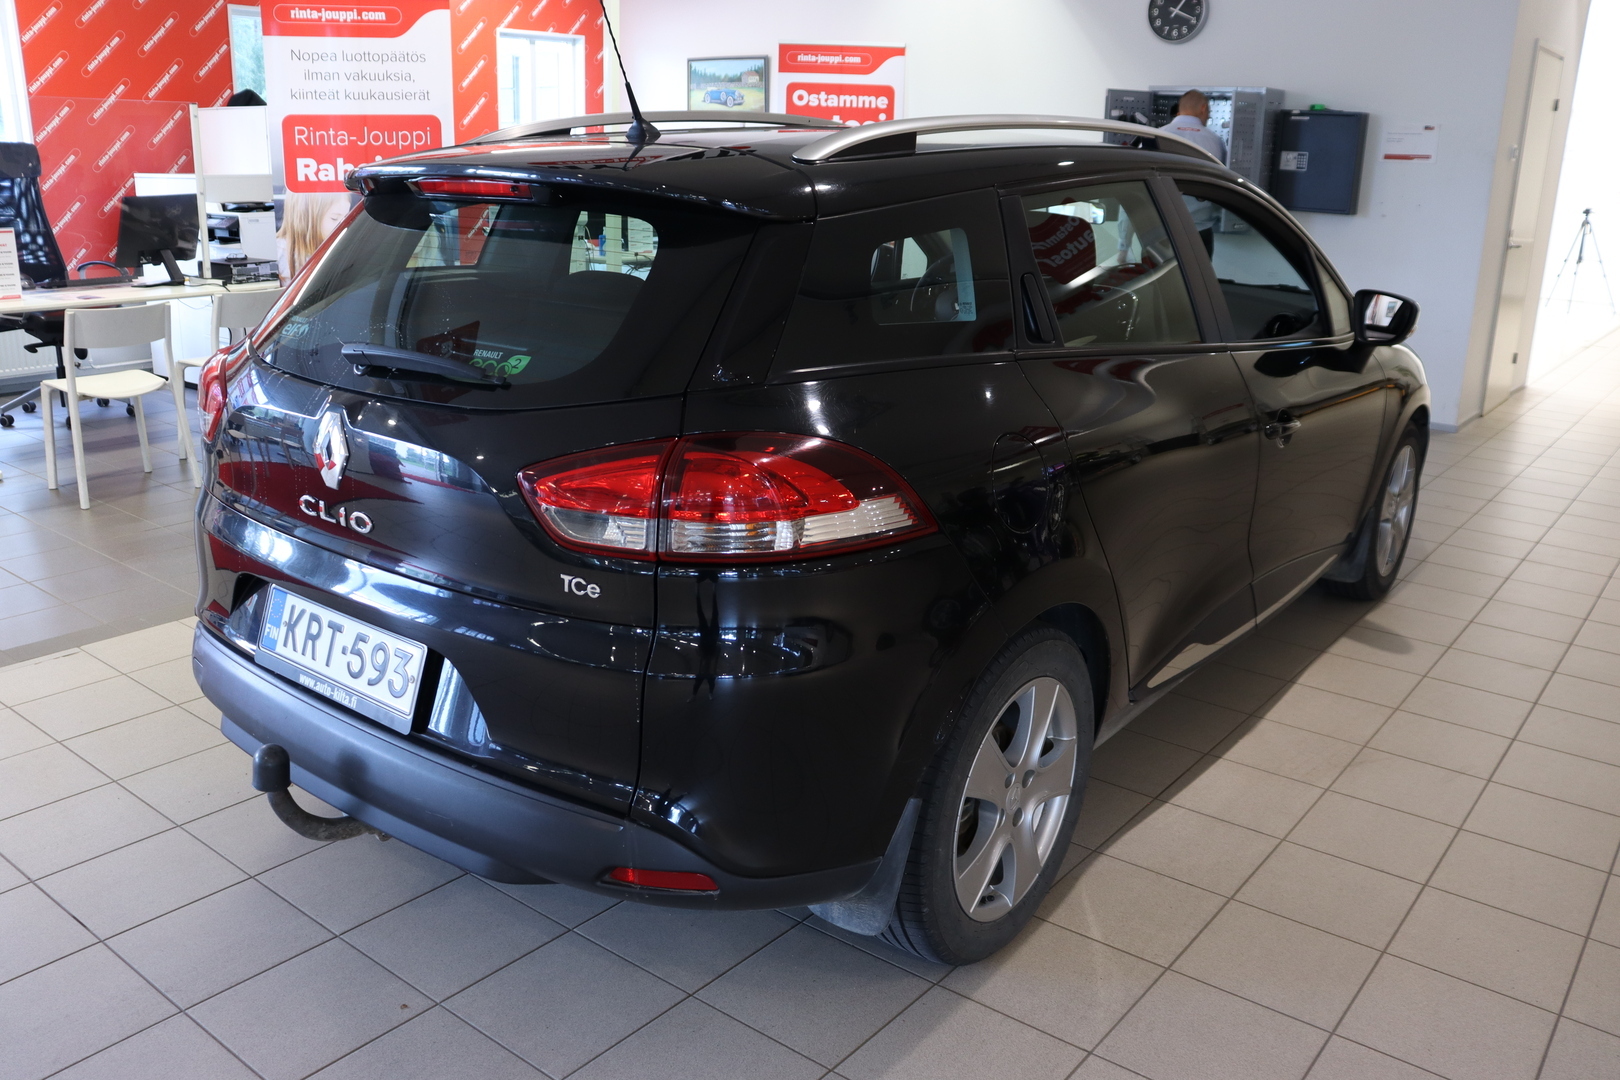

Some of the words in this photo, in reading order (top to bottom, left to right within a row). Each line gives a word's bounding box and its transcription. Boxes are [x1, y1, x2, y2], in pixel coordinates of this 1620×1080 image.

[290, 7, 386, 22] rinta-jouppi.com
[290, 49, 337, 64] Nopea
[342, 50, 426, 65] luottopäätös
[797, 53, 862, 66] rinta-jouppi.com
[304, 69, 340, 81] ilman
[344, 70, 416, 83] vakuuksia,
[290, 88, 340, 101] kiinteät
[344, 89, 430, 101] kuukausierät
[792, 89, 889, 109] Ostamme
[294, 126, 431, 150] Rinta-Jouppi
[473, 348, 504, 359] RENAULT
[298, 494, 374, 534] CLIO
[560, 573, 602, 599] TCe
[264, 624, 280, 641] FIN
[282, 603, 414, 699] KRT-593
[299, 673, 358, 709] www.auto-kilta.fi
